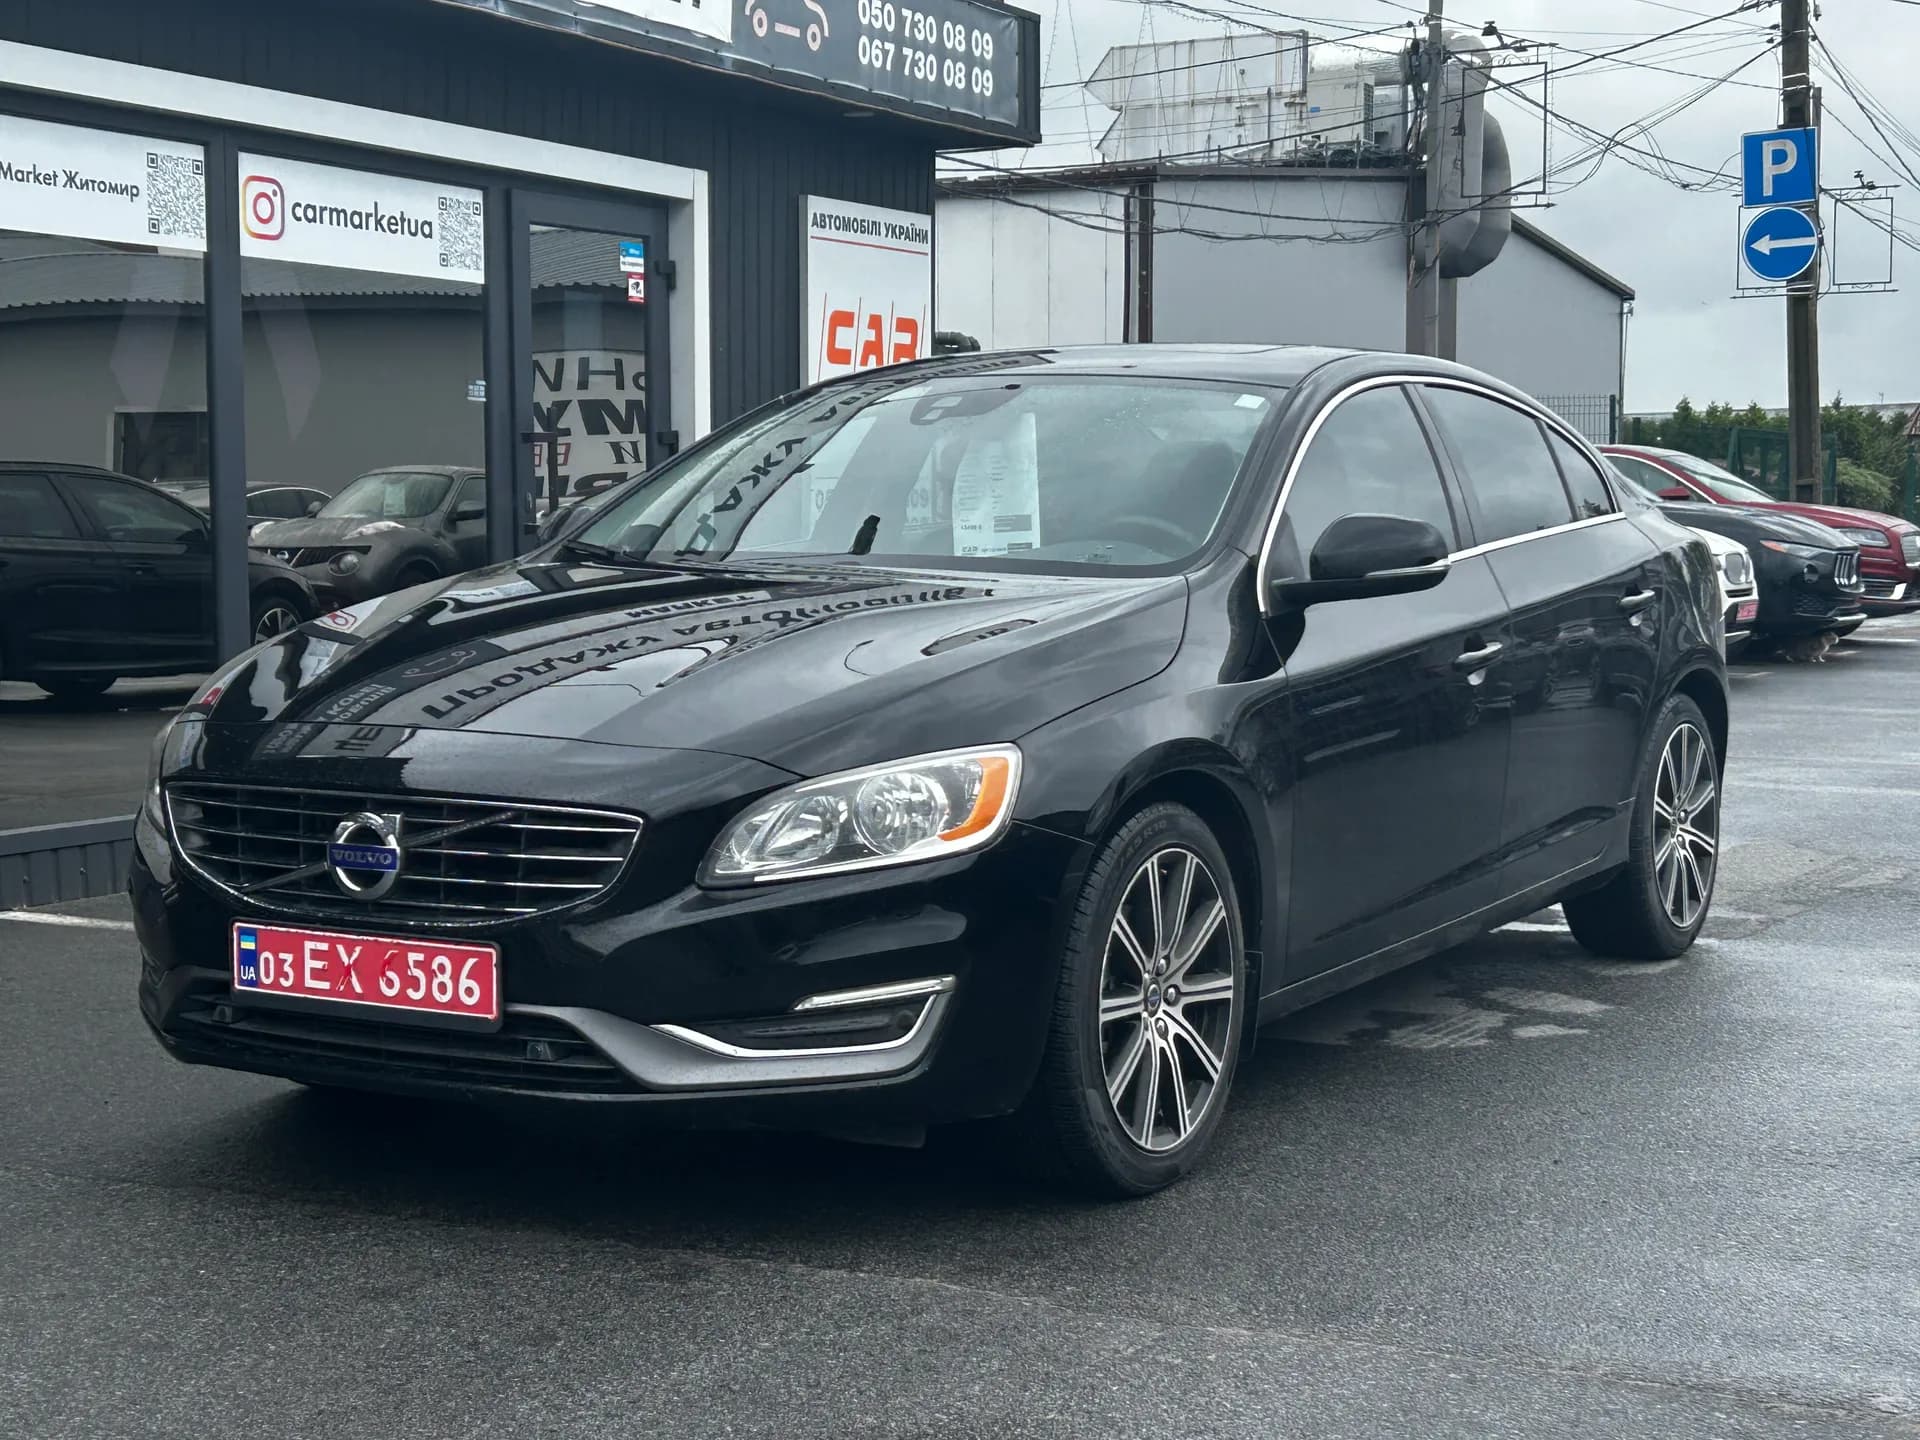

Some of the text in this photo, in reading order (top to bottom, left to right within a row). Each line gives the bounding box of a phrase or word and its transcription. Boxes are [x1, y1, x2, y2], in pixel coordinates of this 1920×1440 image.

[858, 0, 993, 60] 050 730 08 09
[858, 35, 993, 97] 067 730 08 09
[62, 169, 140, 202] Житомир
[1762, 139, 1798, 197] P
[291, 201, 433, 239] carmarketua
[811, 212, 929, 245] АВТОМОБІЛІ УКРАЇНИ
[826, 309, 918, 368] CAR
[331, 848, 392, 865] VOLVO
[240, 965, 256, 981] UA
[259, 940, 481, 1006] 03 EX 6586
